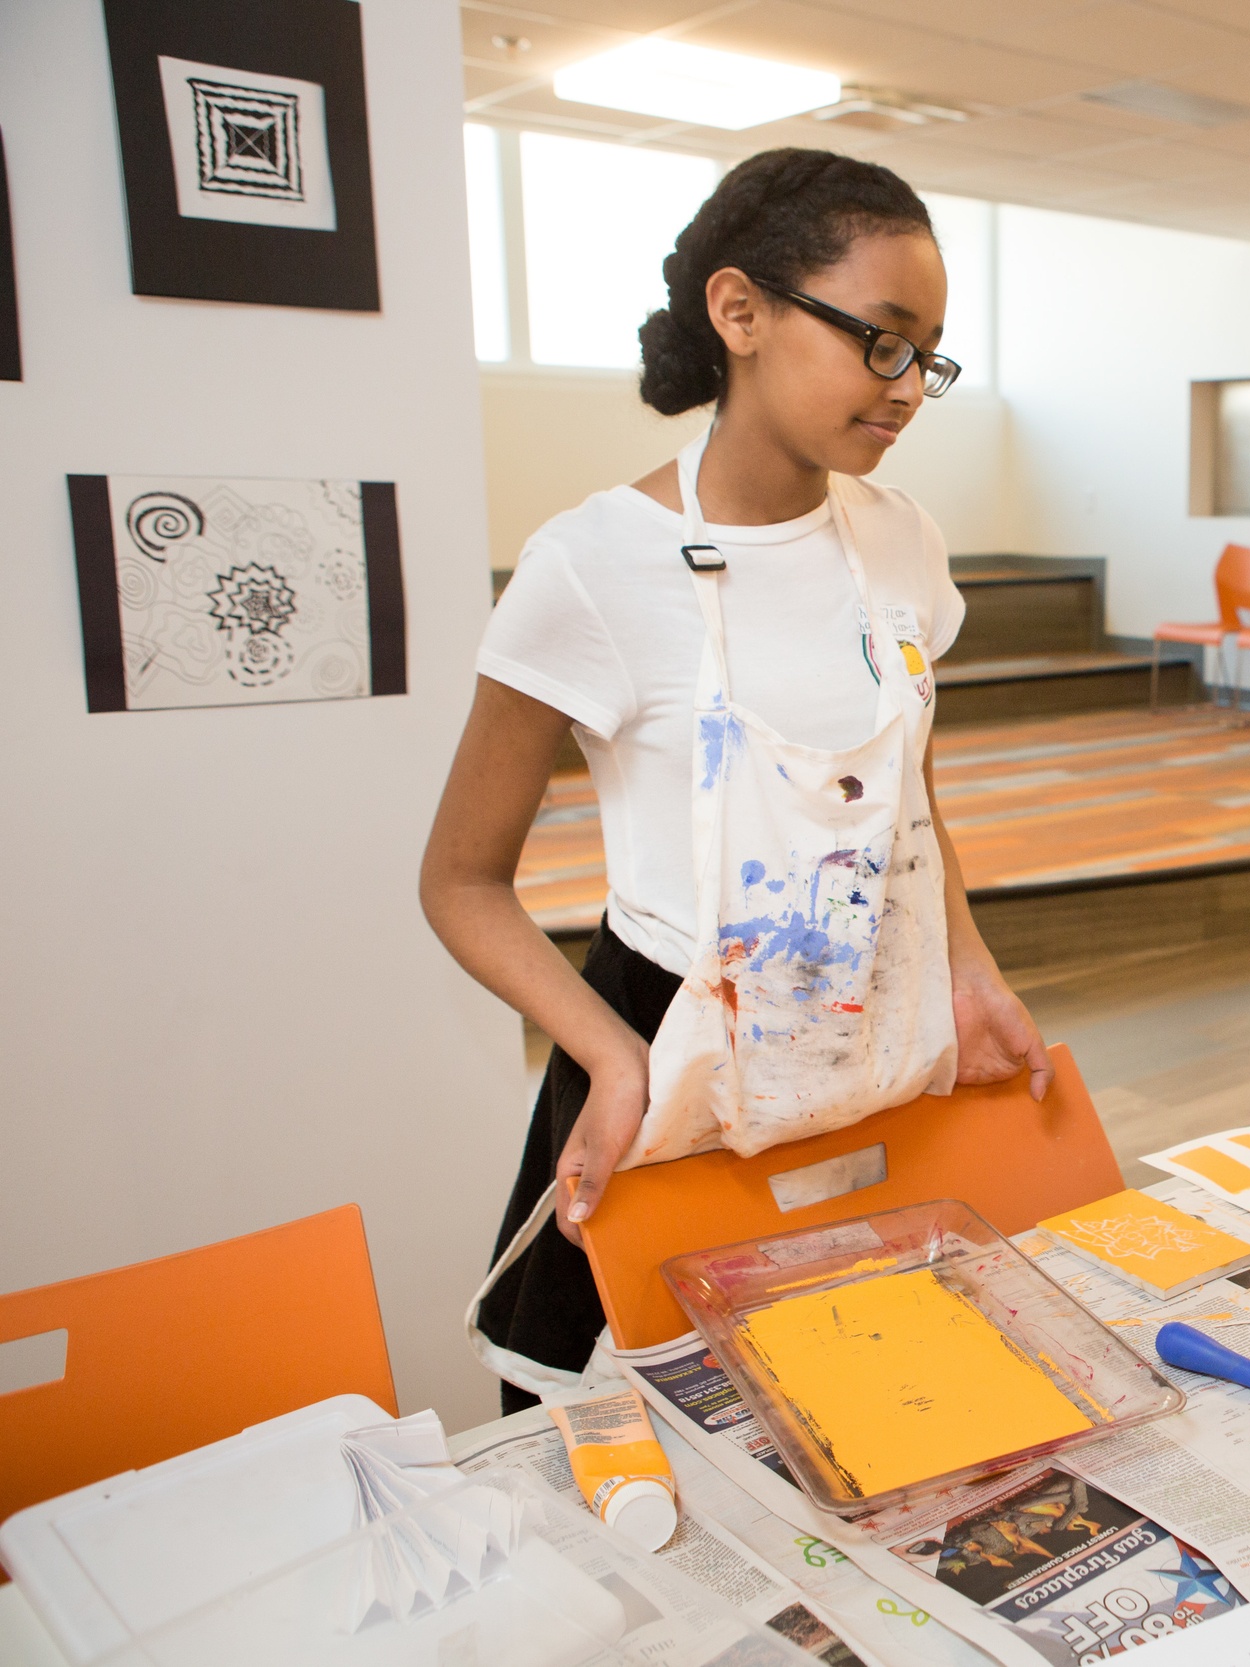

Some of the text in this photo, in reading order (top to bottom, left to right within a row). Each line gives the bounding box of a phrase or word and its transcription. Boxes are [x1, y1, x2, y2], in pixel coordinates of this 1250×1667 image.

[654, 1366, 702, 1383] ALEXANDRIA
[684, 1386, 735, 1409] replaces.com
[962, 1474, 1044, 1520] FREE REMOTE CONTROL!
[1006, 1526, 1119, 1590] LOWEST PRICE GUARANTEED!
[1013, 1526, 1157, 1611] Gas Fireplaces
[1172, 1605, 1194, 1621] TO
[1185, 1613, 1205, 1628] UP
